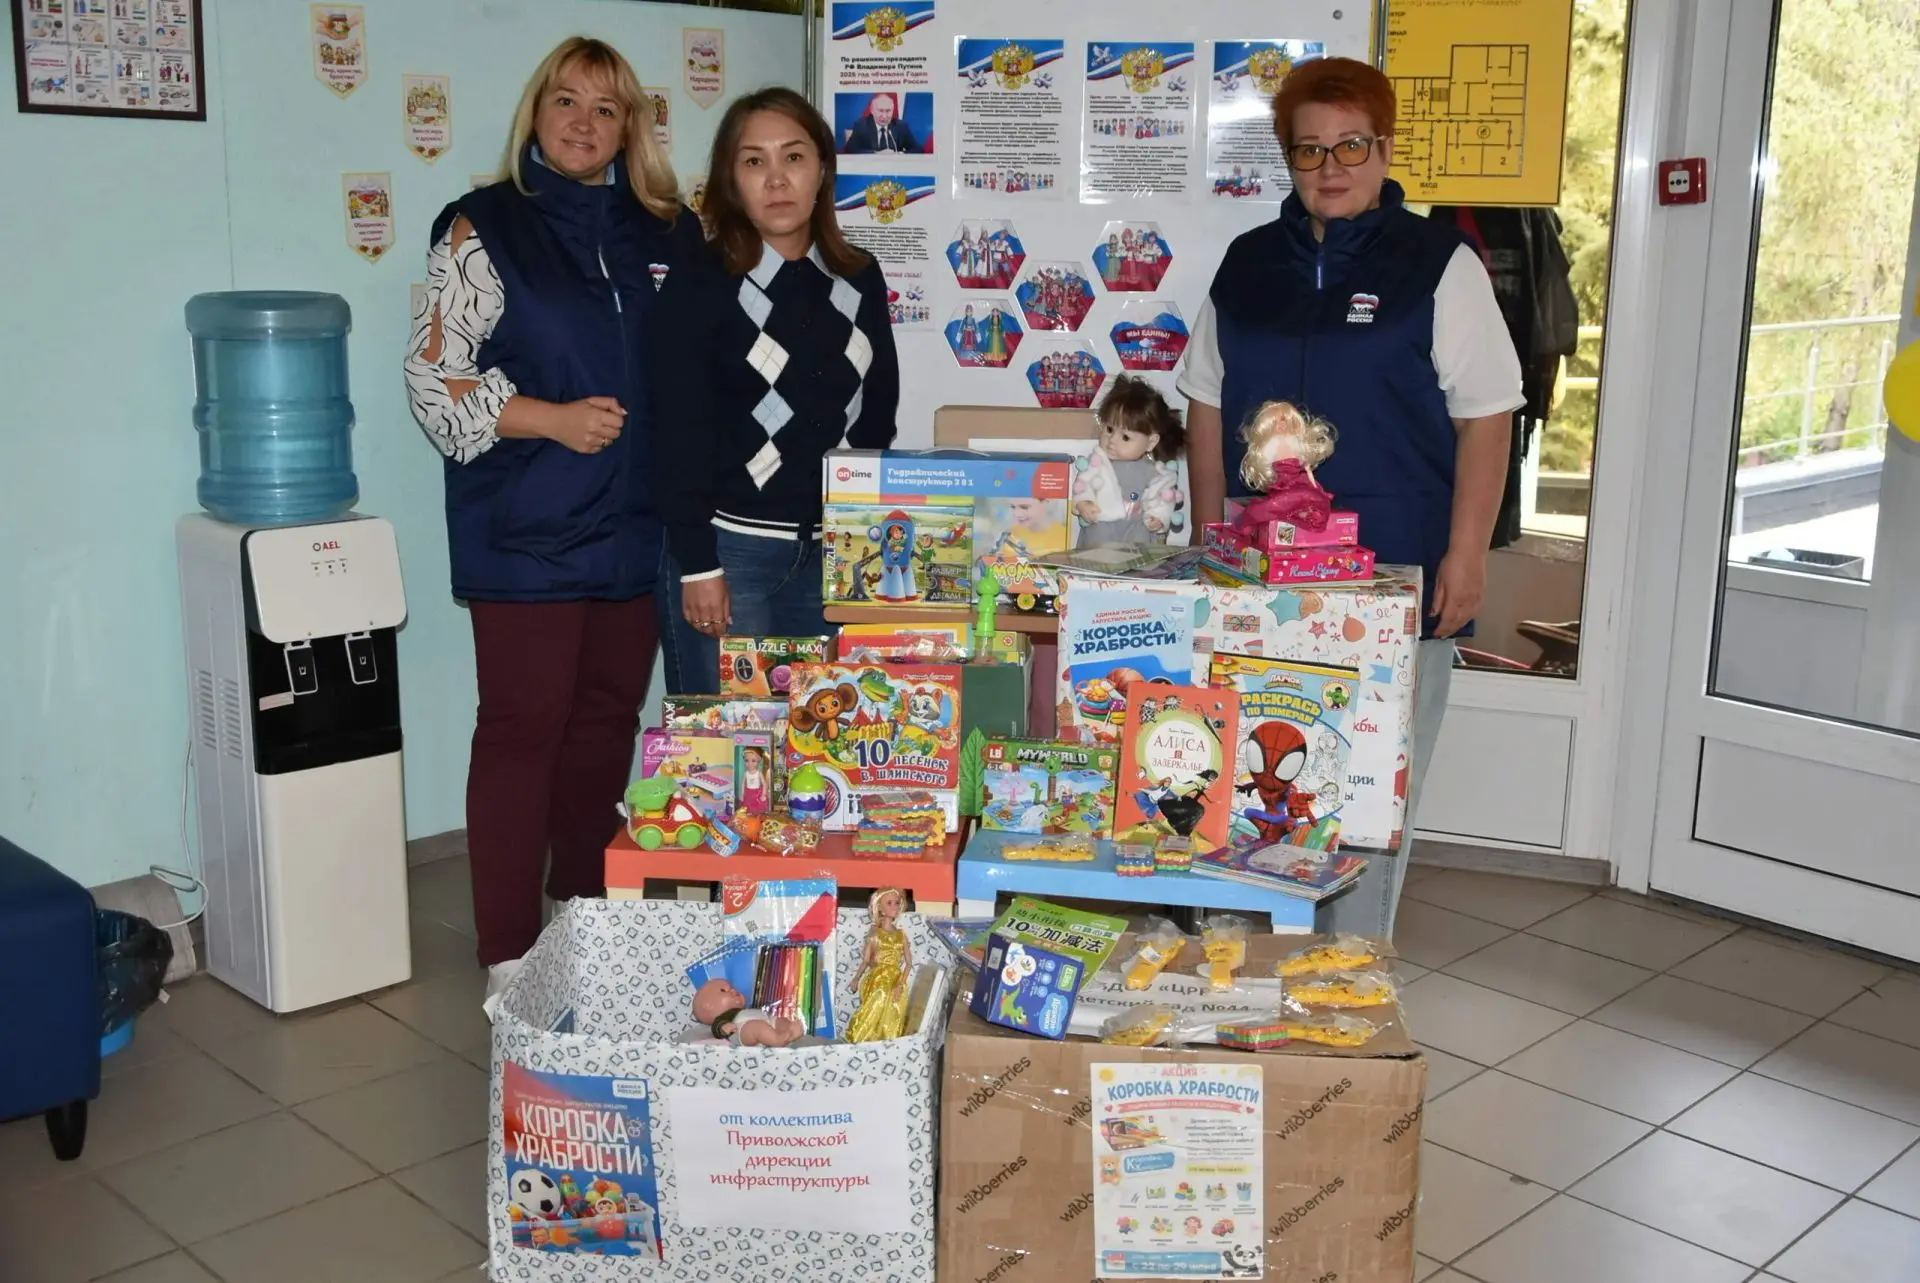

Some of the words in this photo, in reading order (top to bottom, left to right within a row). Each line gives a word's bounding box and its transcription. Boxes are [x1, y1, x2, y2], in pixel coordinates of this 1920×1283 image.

[322, 540, 341, 550] AEL
[1082, 620, 1166, 641] КОРОБКА
[746, 642, 787, 653] PUZZLE
[797, 643, 823, 654] MAXI
[1073, 632, 1177, 656] ХРАБРОСТИ
[1240, 692, 1321, 716] РАСКРАСЬ
[1246, 706, 1260, 716] ПО
[853, 738, 891, 769] 10
[1153, 735, 1205, 752] АЛИСА
[893, 754, 950, 772] ПЕСЕНОК
[1152, 758, 1203, 771] ЗАЗЕРКАЛЬЕ
[876, 768, 948, 786] ШАИНСКОГО
[1161, 1066, 1198, 1077] АКЦИЯ
[958, 1055, 1032, 1118] wildberries
[1107, 1079, 1174, 1101] КОРОБКА
[1178, 1080, 1260, 1104] ХРАБРОСТИ
[1276, 1077, 1353, 1140] wildberries
[521, 1101, 629, 1143] КОРОБКА
[719, 1113, 744, 1125] от
[750, 1112, 853, 1127] коллектива
[726, 1130, 848, 1150] Приволжской
[513, 1131, 643, 1176] ХРАБРОСТИ
[745, 1154, 831, 1171] дирекции
[709, 1169, 870, 1192] инфраструктуры
[956, 1155, 1028, 1214] wildberries
[1269, 1176, 1345, 1237] wildberries
